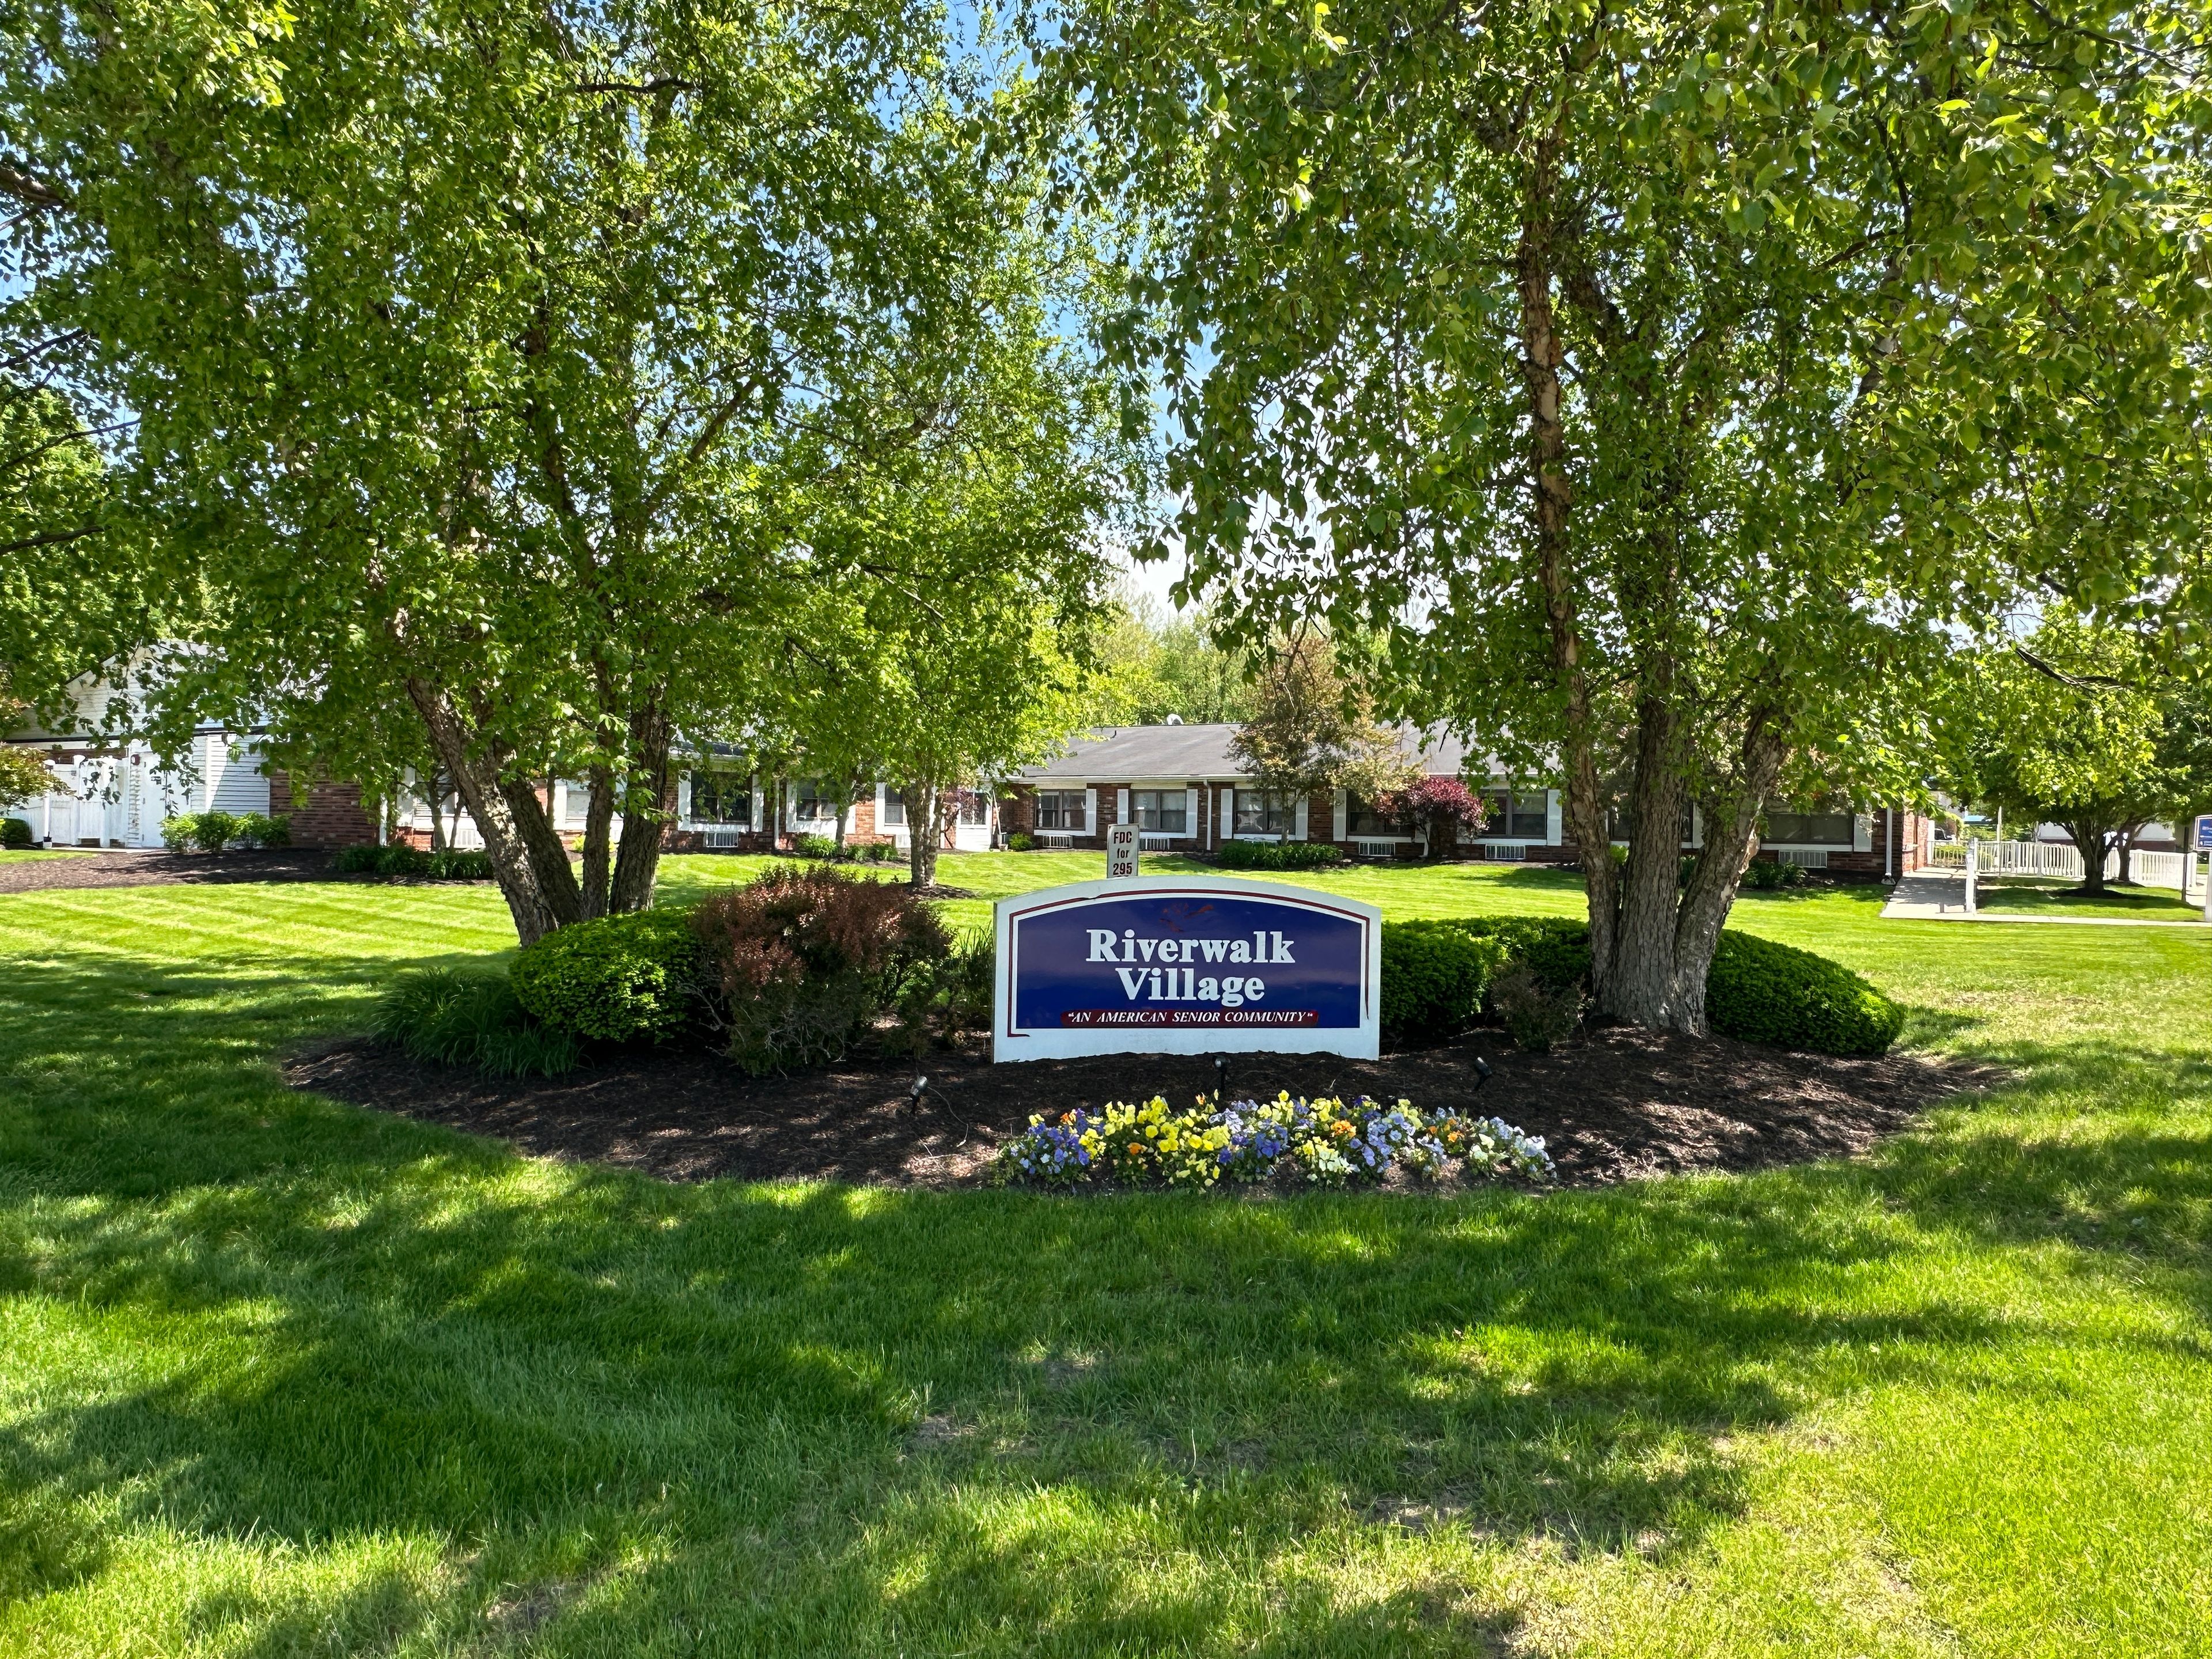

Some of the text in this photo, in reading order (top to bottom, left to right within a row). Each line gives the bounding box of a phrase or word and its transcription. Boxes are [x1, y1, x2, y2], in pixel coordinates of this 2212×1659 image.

[1113, 831, 1132, 844] FDC
[1117, 848, 1130, 858] for
[1113, 862, 1132, 875] 295
[1085, 929, 1296, 963] Riverwalk
[1115, 967, 1265, 1007] Village
[1096, 1012, 1168, 1022] AMERICAN
[1172, 1012, 1221, 1022] SENIOR
